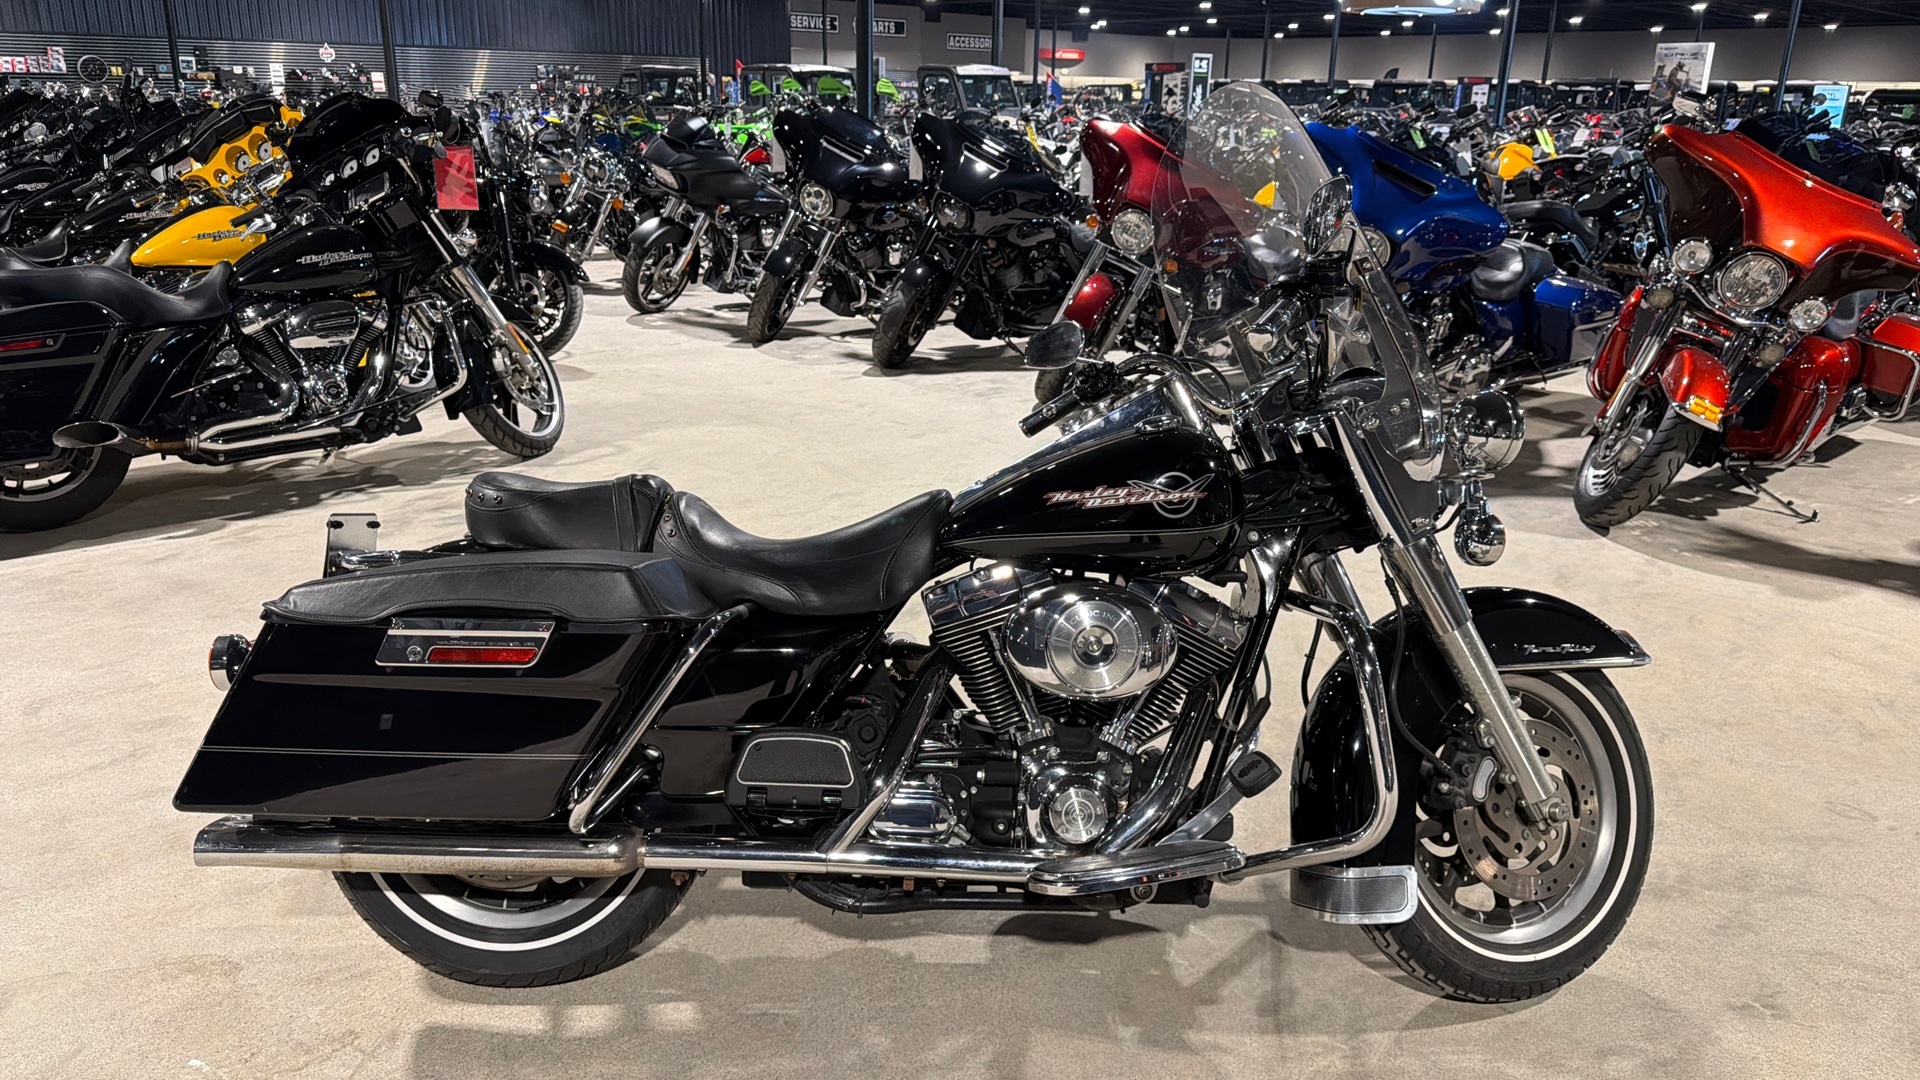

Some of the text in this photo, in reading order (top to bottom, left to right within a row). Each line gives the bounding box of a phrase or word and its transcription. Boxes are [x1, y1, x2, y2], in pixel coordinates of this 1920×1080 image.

[790, 15, 831, 29] SERVICE
[873, 21, 895, 33] ARTS
[949, 36, 992, 49] ACCESSORI
[1078, 489, 1208, 509] Davidson
